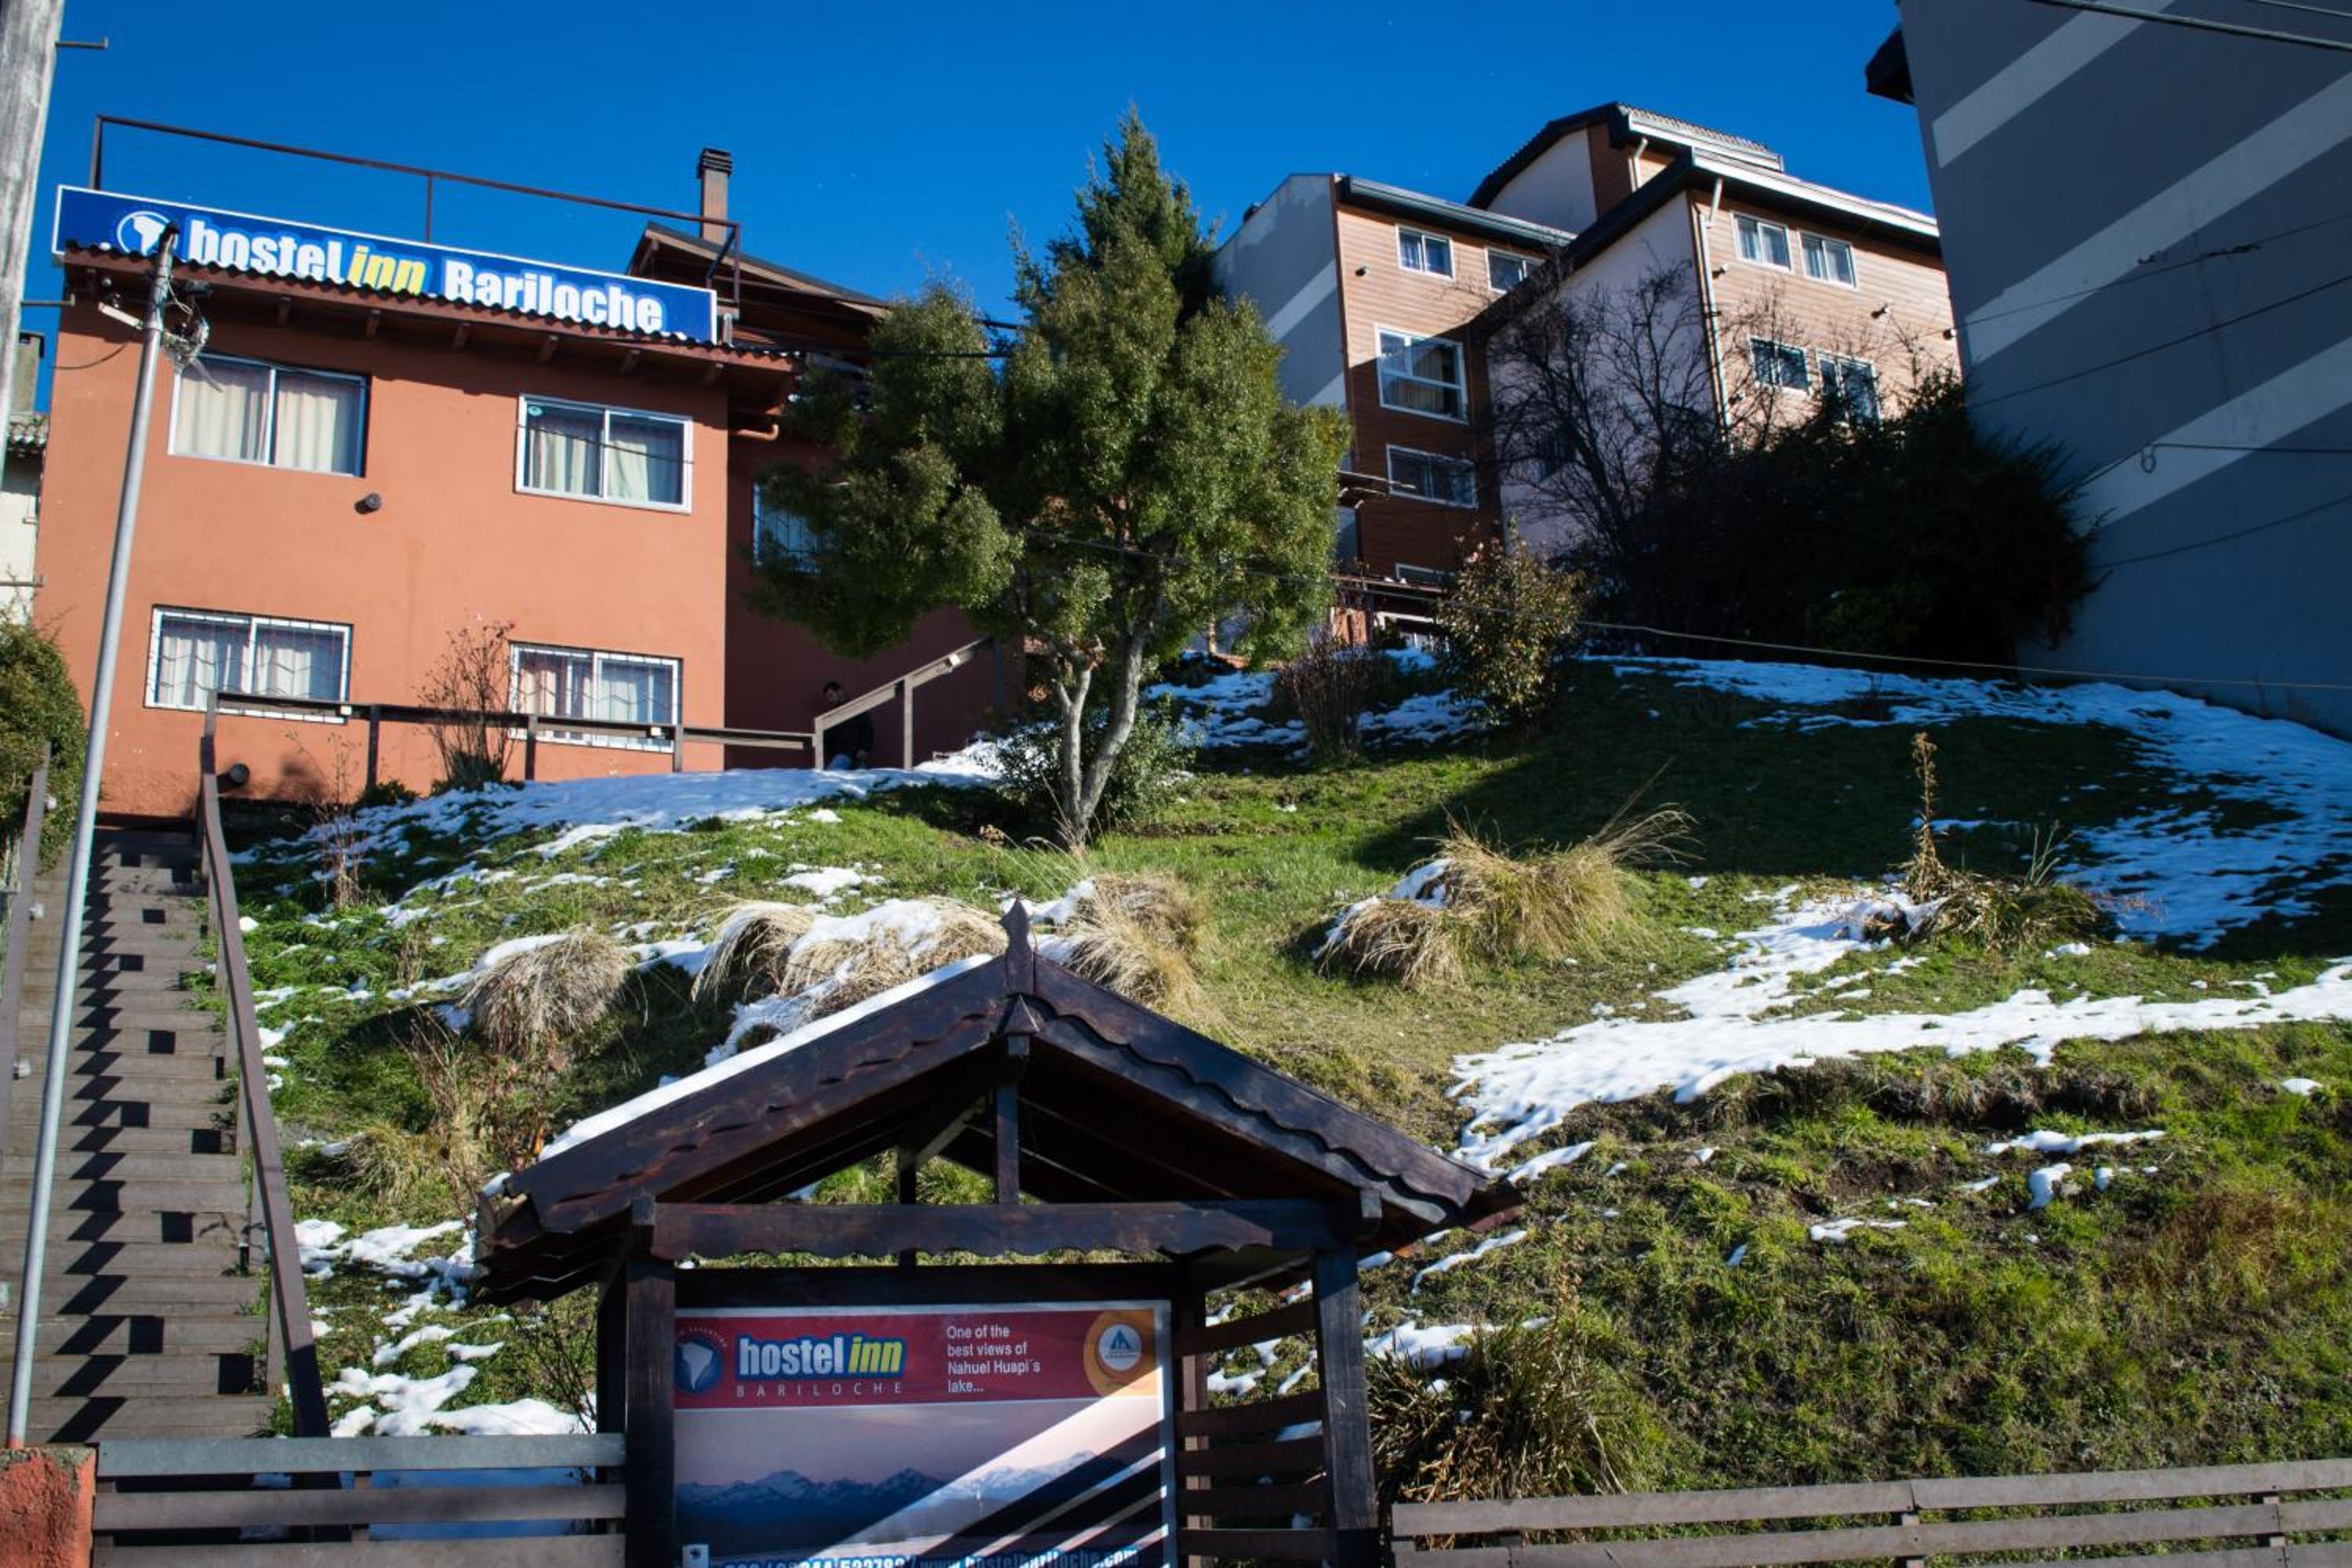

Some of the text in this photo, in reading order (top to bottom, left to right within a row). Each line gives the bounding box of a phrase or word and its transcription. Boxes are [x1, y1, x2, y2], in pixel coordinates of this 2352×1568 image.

[445, 260, 662, 334] Bariloche
[946, 1323, 1010, 1339] One of the
[947, 1341, 1027, 1357] best views of
[948, 1360, 990, 1374] Nahuel
[736, 1381, 902, 1397] BARILOCHE
